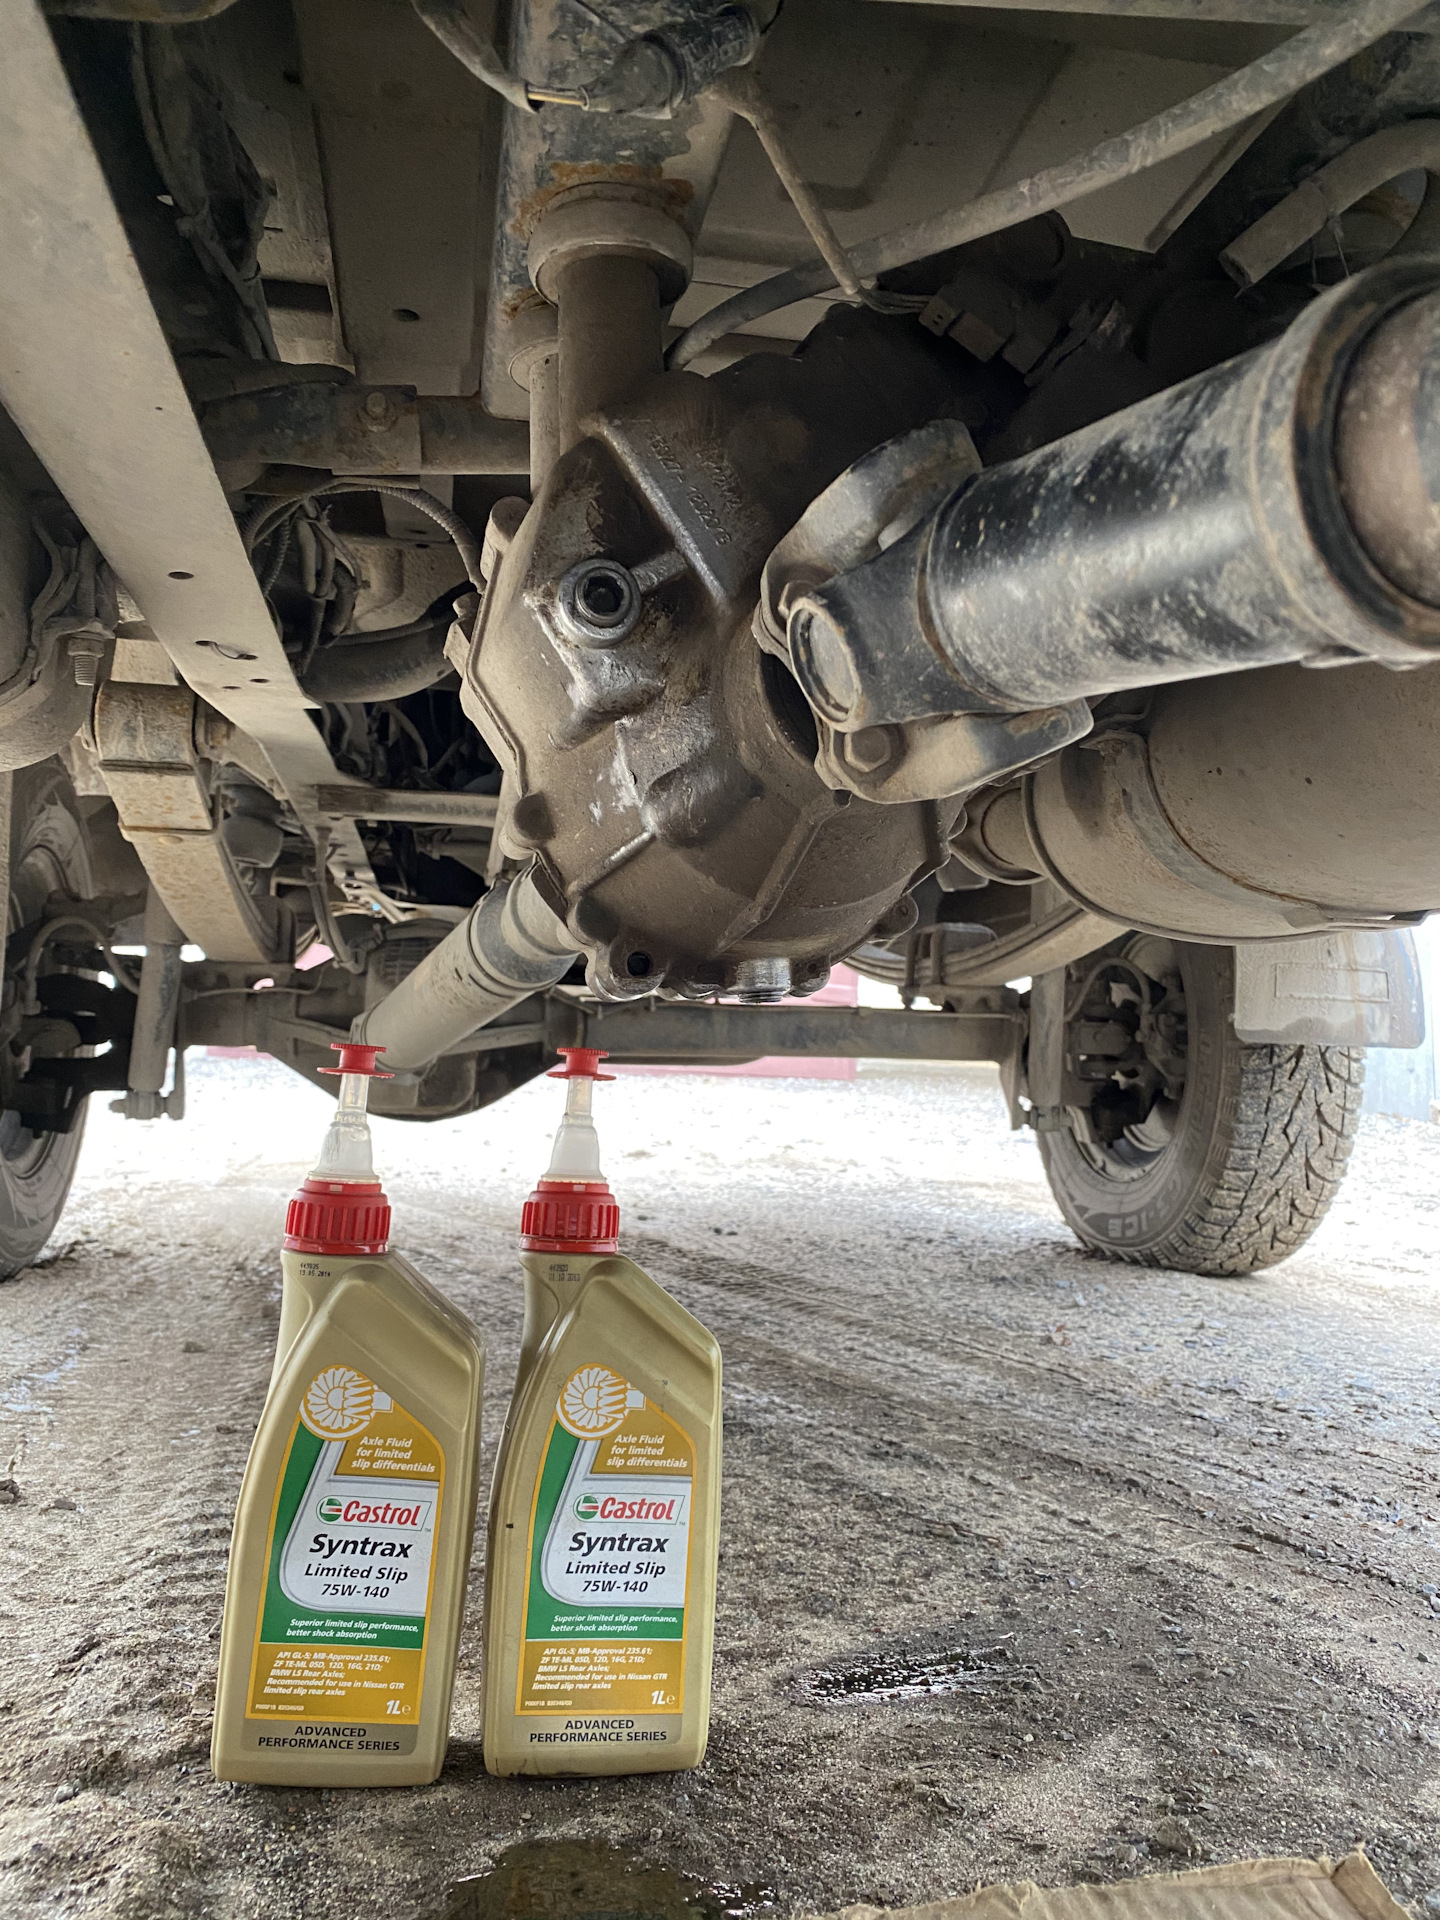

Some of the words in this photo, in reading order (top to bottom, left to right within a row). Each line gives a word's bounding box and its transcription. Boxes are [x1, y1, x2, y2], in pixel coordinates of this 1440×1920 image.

[360, 1436, 385, 1447] Axle
[387, 1437, 412, 1448] Fluid
[614, 1434, 637, 1445] Axle
[639, 1434, 664, 1445] Fluid
[356, 1447, 372, 1459] for
[374, 1448, 412, 1460] limited
[611, 1445, 626, 1456] for
[628, 1445, 664, 1456] limited
[351, 1458, 370, 1470] slip
[372, 1459, 435, 1473] differentials
[606, 1456, 625, 1469] slip
[627, 1456, 688, 1469] differentials
[343, 1500, 421, 1527] Castrol
[600, 1497, 675, 1520] Castrol
[308, 1533, 413, 1559] Syntrax
[568, 1531, 669, 1557] Syntrax
[304, 1563, 372, 1579] Limited
[375, 1565, 408, 1584] Slip
[565, 1561, 631, 1575] Limited
[634, 1561, 666, 1578] Slip
[321, 1584, 390, 1599] 75W-140
[582, 1580, 649, 1593] 75W-140
[554, 1613, 586, 1624] Superior
[587, 1613, 614, 1623] limited
[615, 1614, 628, 1625] slip
[629, 1614, 678, 1625] performance,
[290, 1618, 323, 1629] Superior
[325, 1619, 353, 1629] limited
[354, 1620, 369, 1631] slip
[369, 1621, 419, 1633] performance,
[550, 1624, 574, 1632] better
[575, 1623, 596, 1632] shock
[598, 1623, 638, 1633] absorption
[286, 1628, 310, 1638] better
[312, 1628, 335, 1638] shock
[336, 1629, 377, 1640] absorption
[277, 1651, 291, 1659] API
[313, 1652, 362, 1662] MB-Approval
[363, 1654, 391, 1663] 235.61;
[577, 1647, 625, 1656] MB-Approval
[626, 1647, 653, 1655] 235.61;
[273, 1660, 284, 1668] ZF
[587, 1665, 610, 1673] Axles;
[270, 1668, 291, 1676] BMW
[292, 1669, 302, 1677] LS
[302, 1669, 321, 1677] Rear
[321, 1670, 346, 1678] Axles;
[535, 1673, 590, 1681] Recommended
[591, 1673, 603, 1681] for
[266, 1677, 324, 1686] Recommended
[325, 1679, 337, 1687] for
[353, 1680, 361, 1688] in
[362, 1681, 388, 1689] Nissan
[532, 1682, 560, 1690] limited
[560, 1682, 574, 1691] slip
[575, 1682, 591, 1690] rear
[592, 1682, 611, 1690] axles
[263, 1686, 292, 1694] limited
[292, 1687, 307, 1696] slip
[308, 1688, 324, 1696] rear
[325, 1688, 346, 1696] axles
[564, 1719, 634, 1730] ADVANCED
[294, 1725, 367, 1738] ADVANCED
[529, 1731, 623, 1743] PERFORMANCE
[627, 1731, 667, 1742] SERIES
[258, 1737, 354, 1750] PERFORMANCE
[357, 1740, 400, 1751] SERIES
